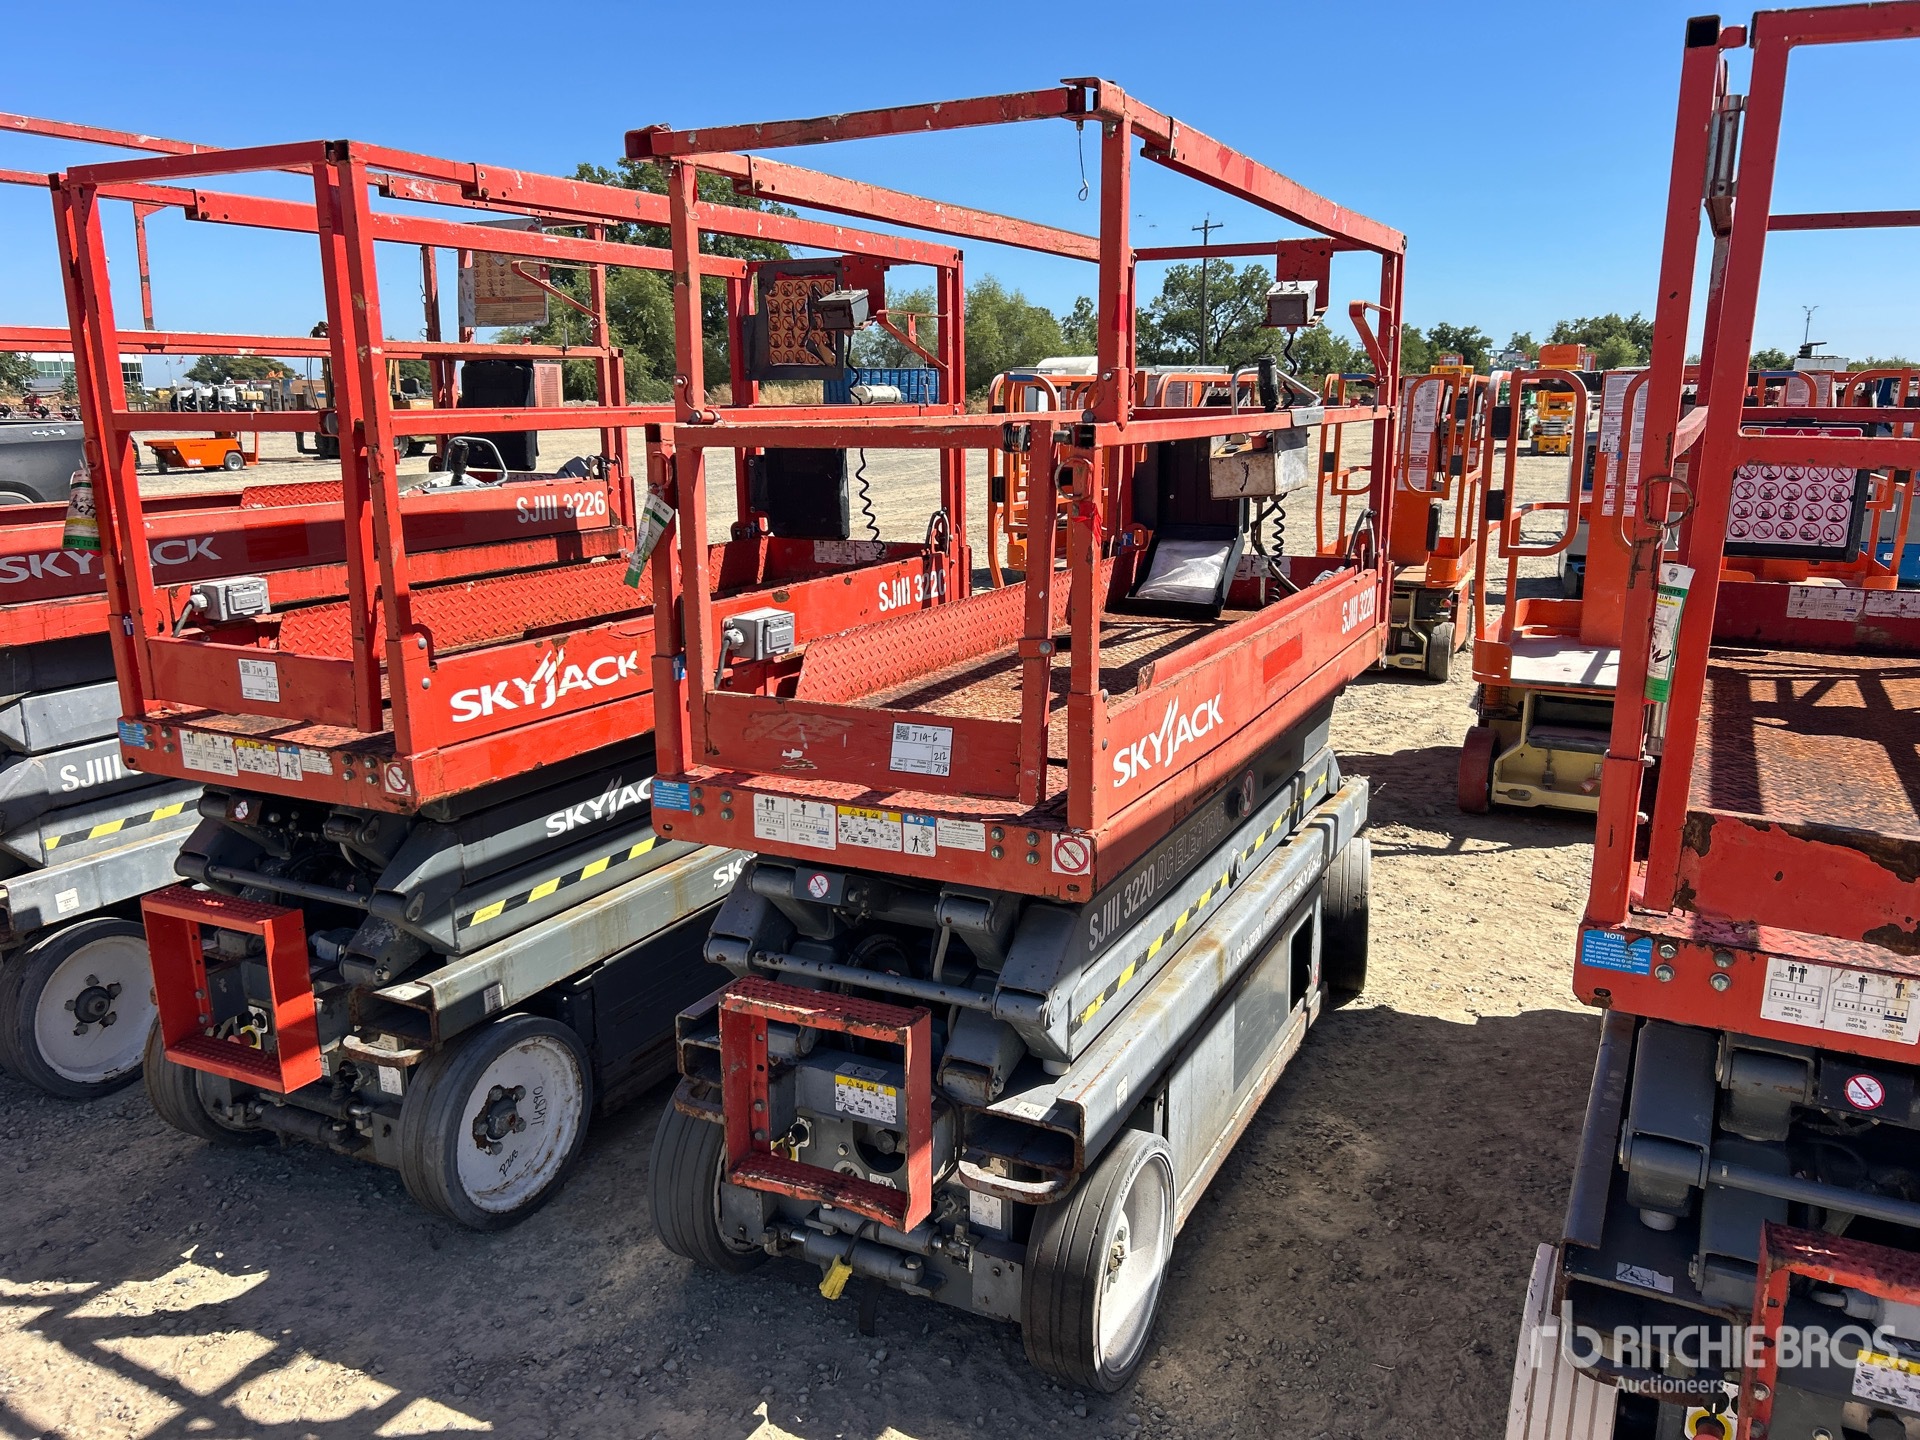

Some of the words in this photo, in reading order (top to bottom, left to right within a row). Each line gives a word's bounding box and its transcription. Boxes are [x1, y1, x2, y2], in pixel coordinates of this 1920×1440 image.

[516, 494, 558, 524] SJIII
[563, 490, 606, 519] 3226
[878, 576, 911, 612] SJIII
[450, 647, 645, 723] SKYJACK
[1112, 693, 1224, 788] SKYJACK
[60, 753, 122, 792] SJIII
[546, 775, 655, 838] SKYJAC
[1088, 893, 1122, 952] SJIII
[1124, 864, 1155, 919] 3220
[1156, 846, 1174, 890] DC
[1174, 802, 1225, 872] ELECTRIC
[1604, 932, 1626, 941] NOTI
[1847, 1016, 1858, 1024] 227
